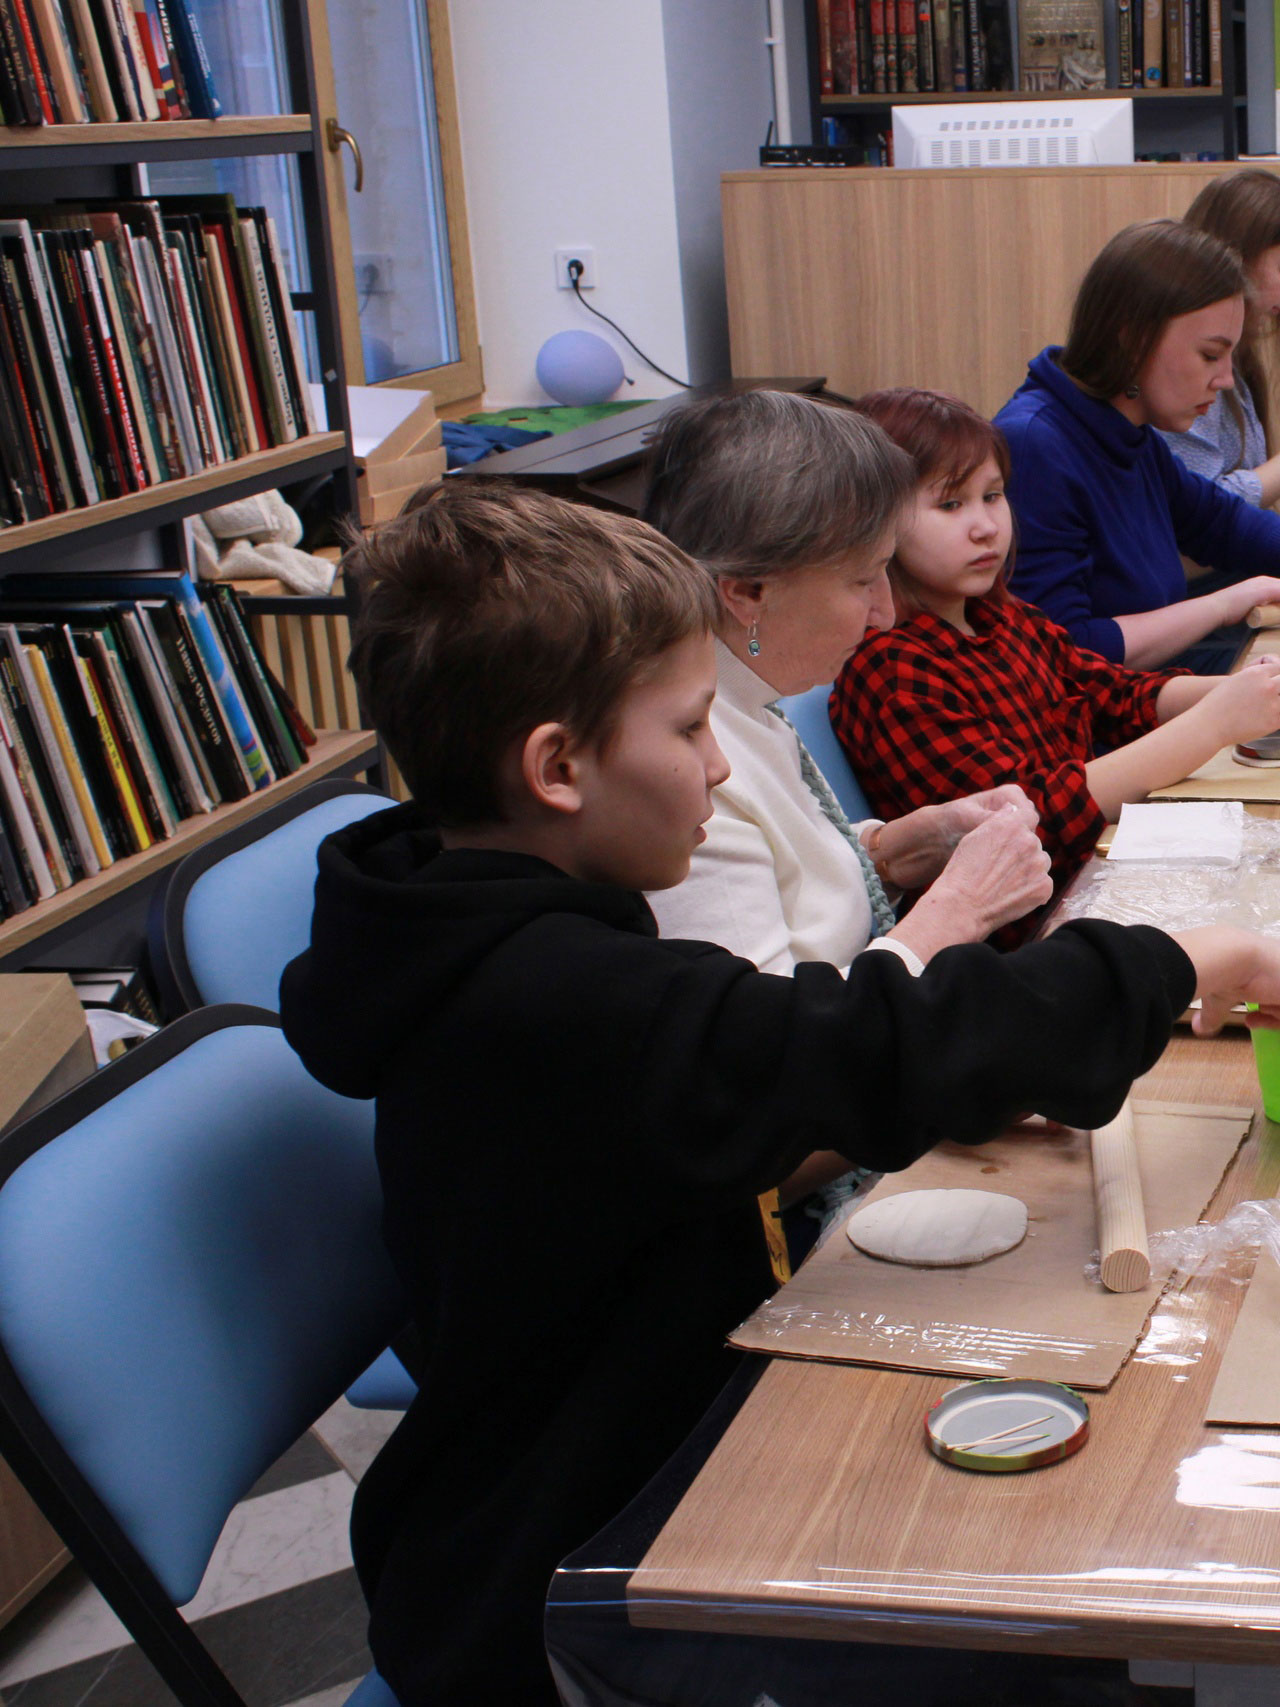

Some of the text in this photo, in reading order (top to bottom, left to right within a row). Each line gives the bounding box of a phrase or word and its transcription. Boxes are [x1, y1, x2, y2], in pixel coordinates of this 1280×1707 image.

[255, 269, 283, 378] КУСТОДИЕВ
[176, 638, 221, 746] Павел Федотов
